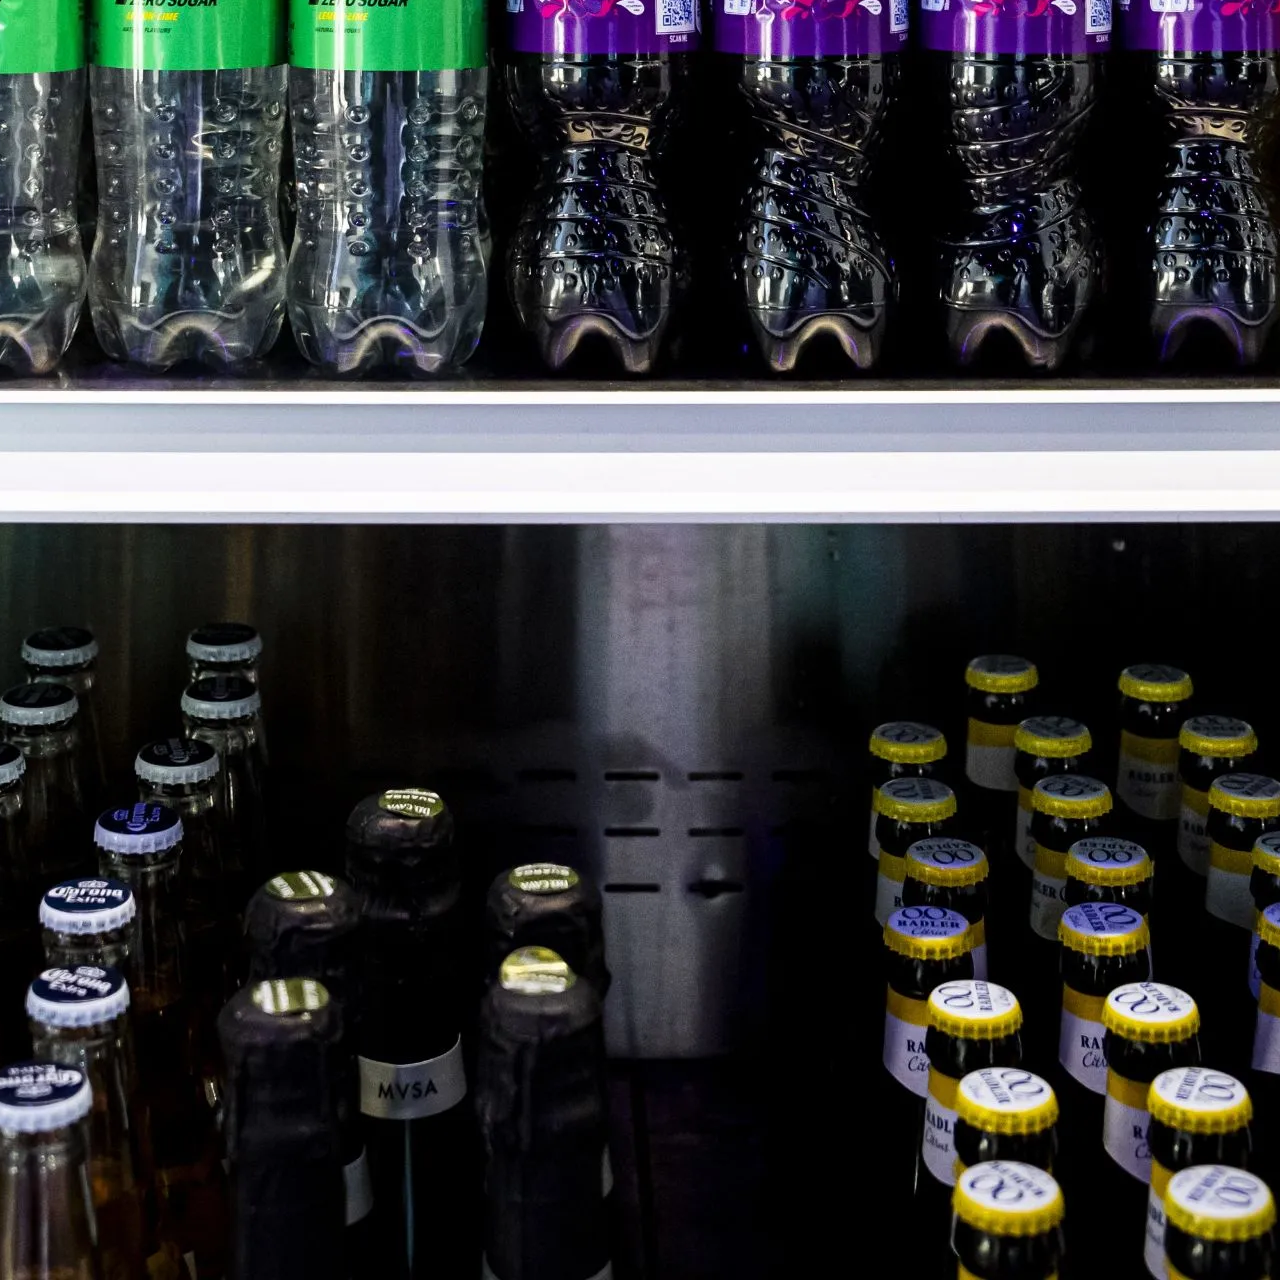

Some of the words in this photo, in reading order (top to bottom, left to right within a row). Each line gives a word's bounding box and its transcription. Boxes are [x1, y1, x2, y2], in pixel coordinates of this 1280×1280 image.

[48, 885, 124, 900] Corona
[65, 894, 106, 904] Extra
[897, 919, 960, 930] RADLER
[39, 967, 113, 995] Corona
[49, 980, 88, 997] Extra
[974, 980, 993, 1012] RADLER
[1139, 982, 1181, 1013] RADLER
[378, 1079, 439, 1101] MVSA
